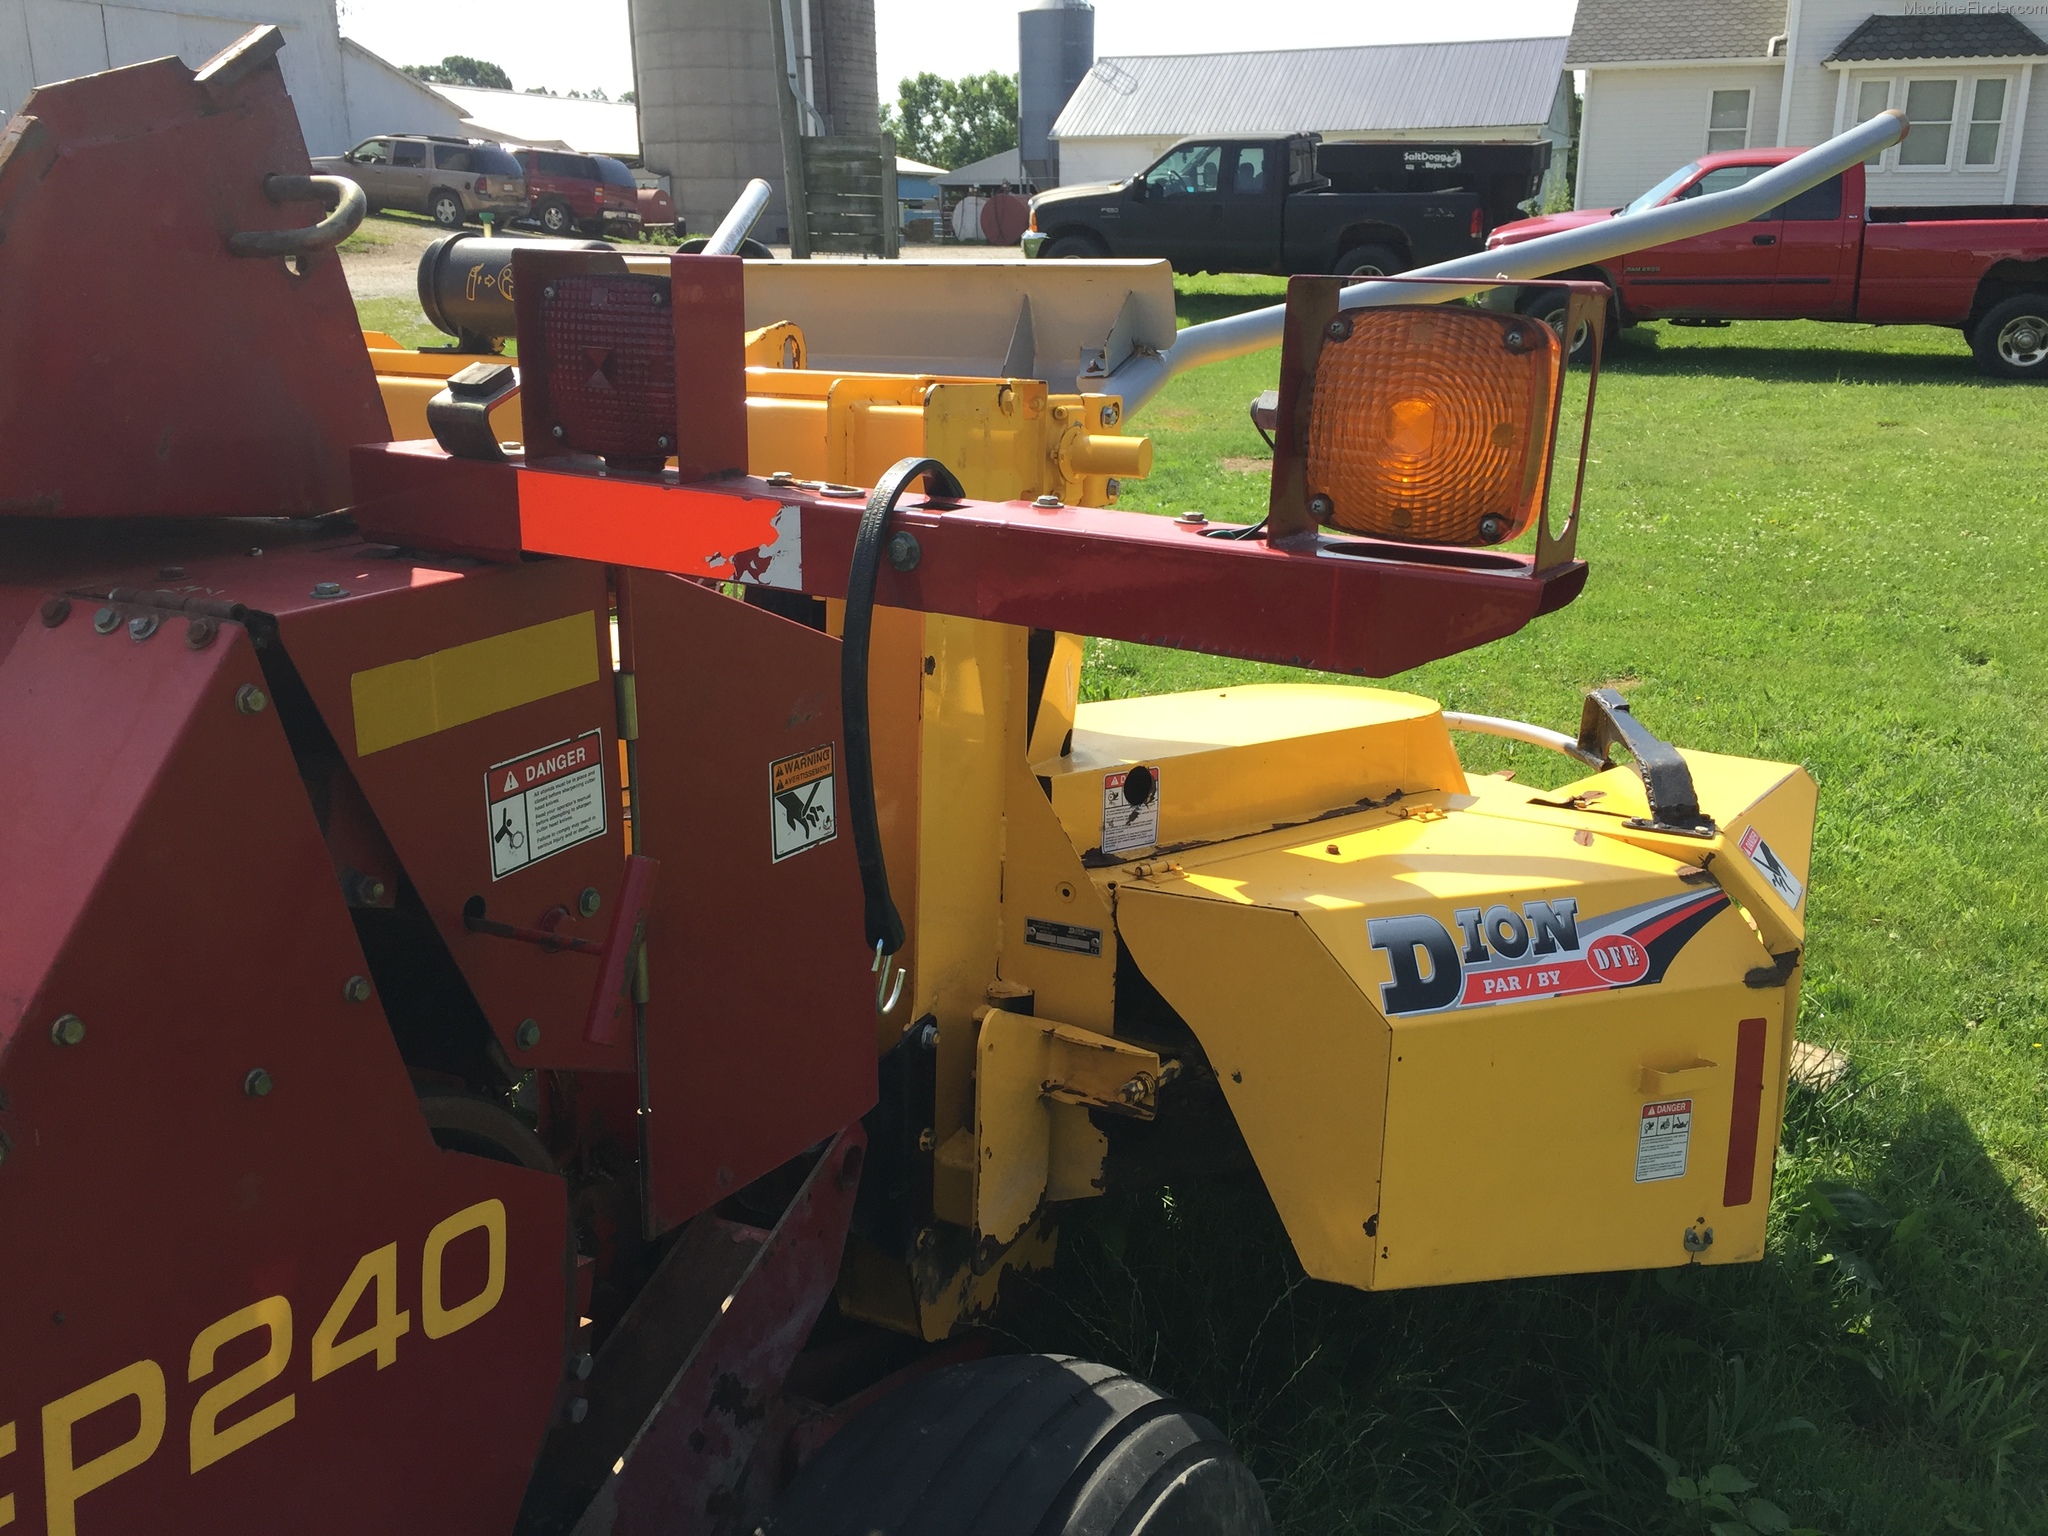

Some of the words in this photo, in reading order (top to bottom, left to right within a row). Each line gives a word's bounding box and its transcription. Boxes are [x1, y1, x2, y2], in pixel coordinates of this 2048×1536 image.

[1404, 152, 1446, 162] SaltDogg
[525, 747, 586, 783] DANGER
[784, 749, 830, 774] WARNING
[785, 763, 831, 786] AVERTISSEMENT
[1366, 897, 1581, 1016] DION
[1593, 944, 1640, 970] DFE
[1483, 975, 1522, 995] PAR
[1525, 973, 1533, 990] /
[1538, 970, 1561, 988] BY
[1656, 1102, 1686, 1114] DANGER
[0, 1198, 507, 1536] P240
